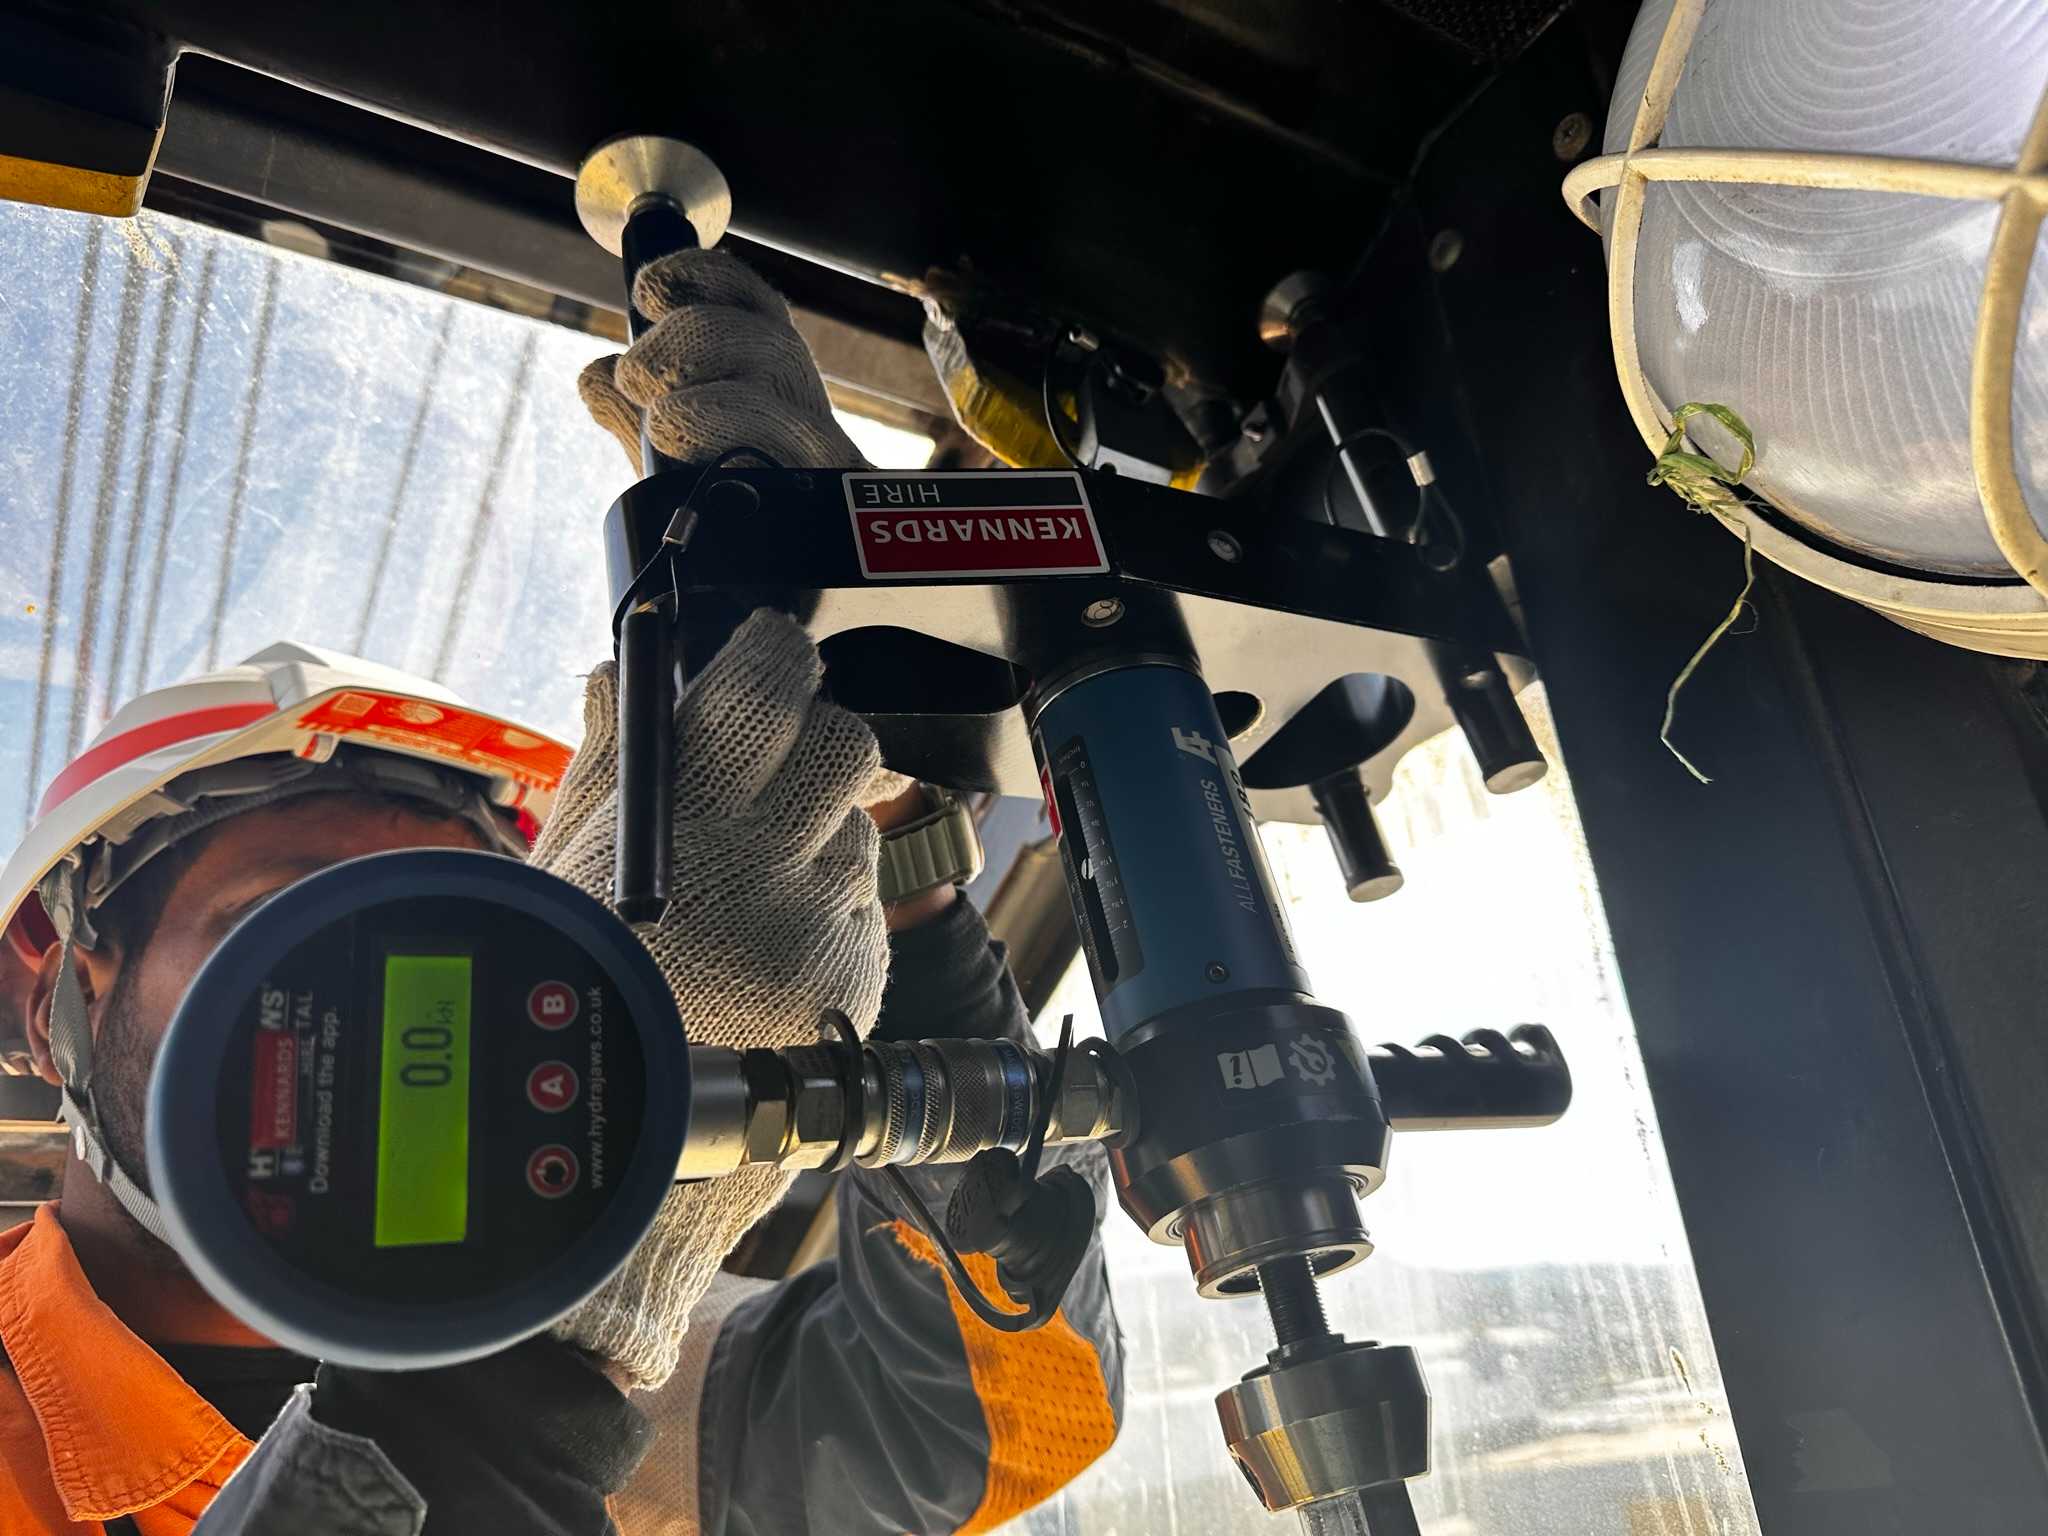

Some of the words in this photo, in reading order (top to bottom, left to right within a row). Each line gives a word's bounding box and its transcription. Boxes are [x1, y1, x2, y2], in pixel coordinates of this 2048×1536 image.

[862, 483, 942, 504] HIRE
[869, 516, 1083, 544] KENNARDS
[542, 993, 566, 1015] B
[321, 1007, 340, 1048] app.
[317, 1053, 336, 1087] the
[401, 1026, 454, 1088] 0.0
[272, 1036, 295, 1139] KENNARDS
[540, 1073, 565, 1098] A
[587, 986, 607, 1189] www.hydrajaws.co.uk
[309, 1090, 334, 1194] Download
